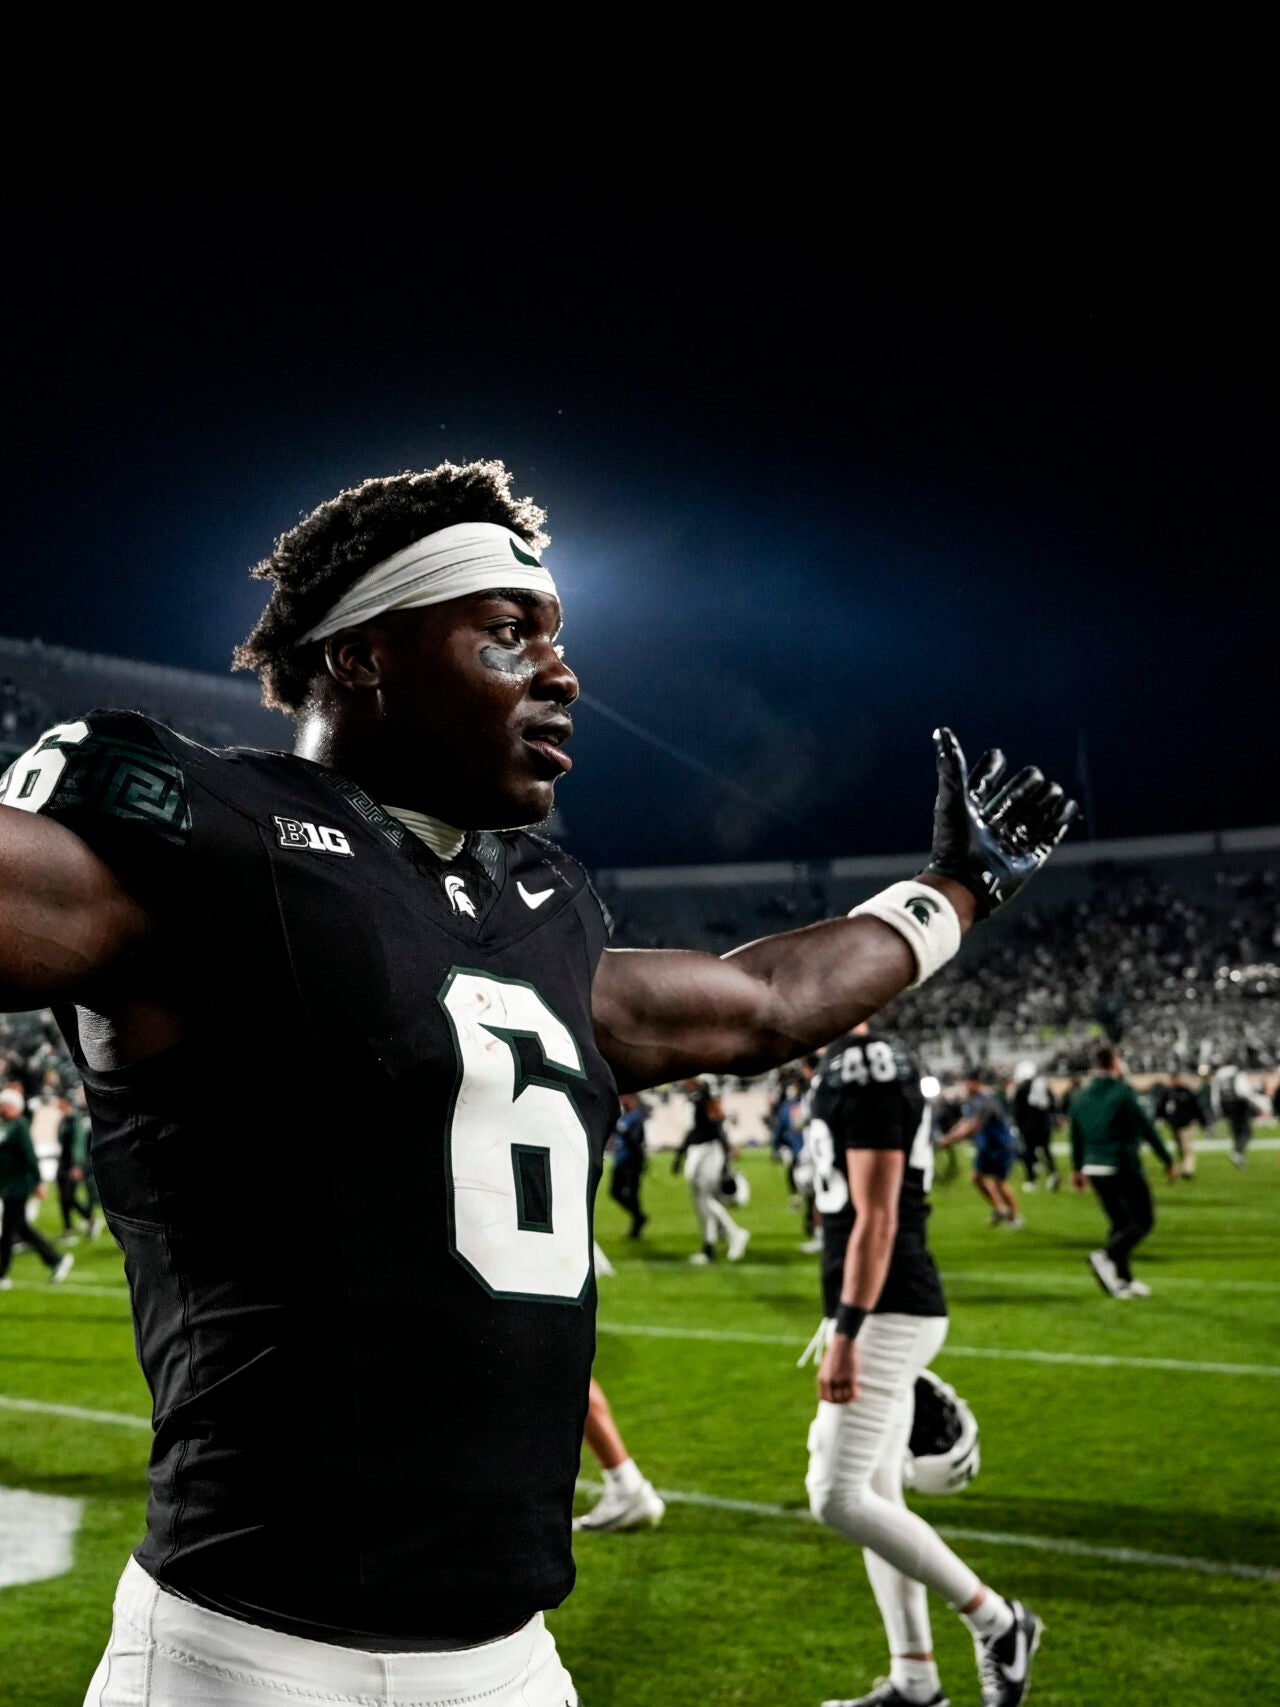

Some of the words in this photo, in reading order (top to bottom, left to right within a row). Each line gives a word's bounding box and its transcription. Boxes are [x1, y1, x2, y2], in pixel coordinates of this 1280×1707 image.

[1, 719, 93, 814] 6
[841, 1041, 898, 1087] 48
[437, 965, 588, 1305] 6
